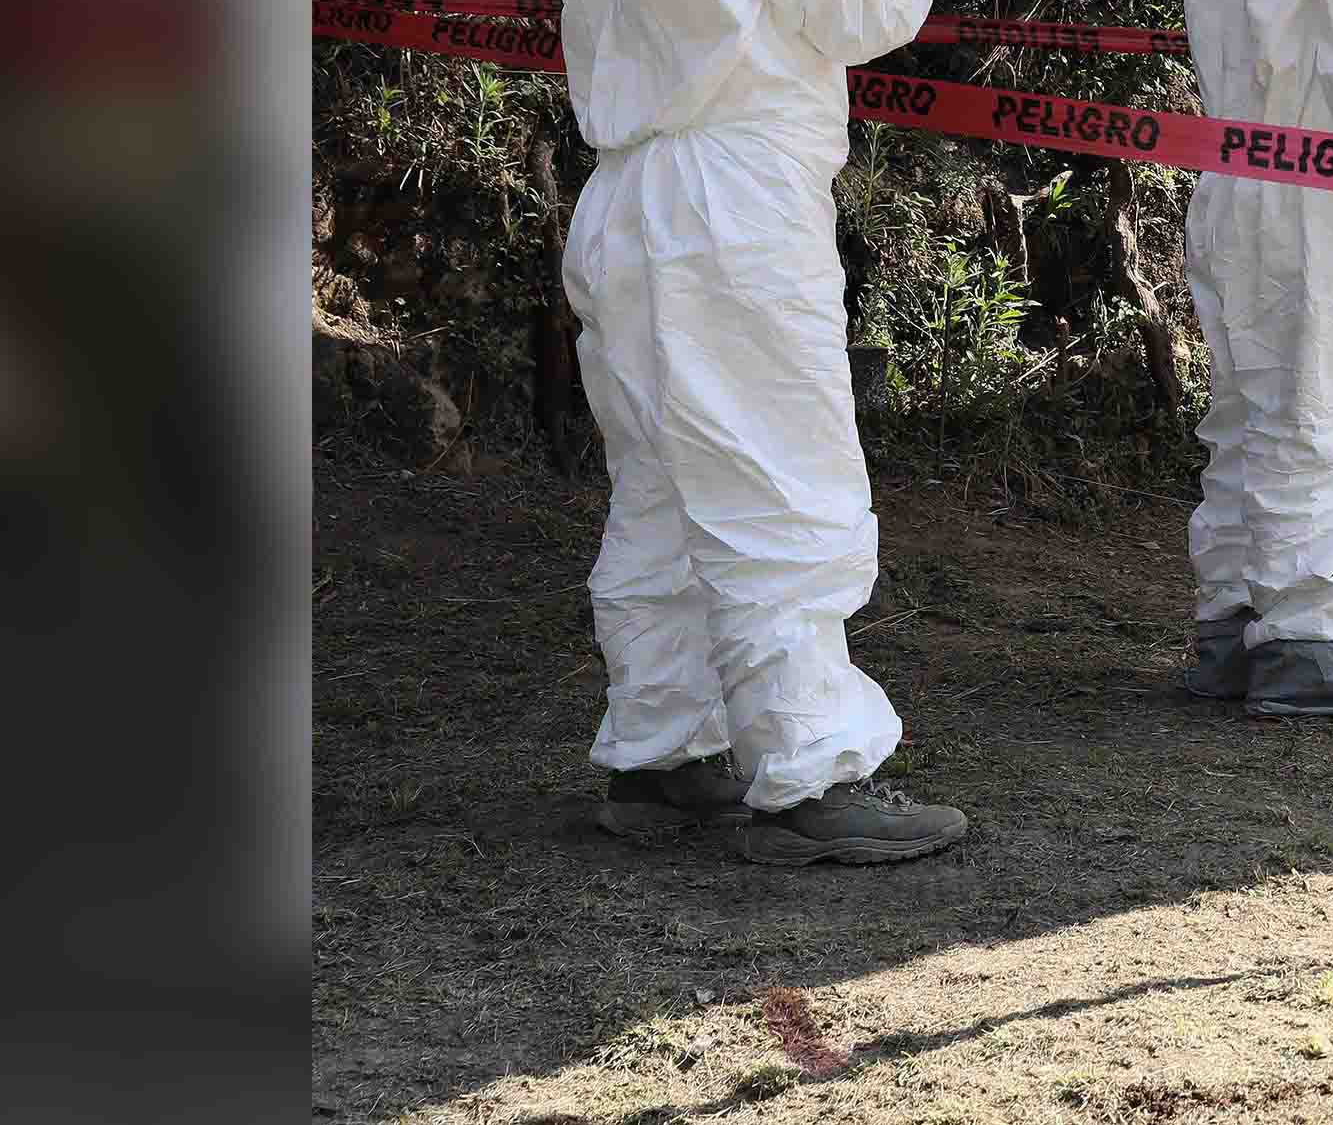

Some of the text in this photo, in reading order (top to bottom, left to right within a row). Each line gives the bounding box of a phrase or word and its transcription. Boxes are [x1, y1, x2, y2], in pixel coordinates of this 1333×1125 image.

[432, 19, 561, 58] PELIGRO
[850, 74, 937, 115] IGRO
[992, 94, 1161, 151] PELIGRO
